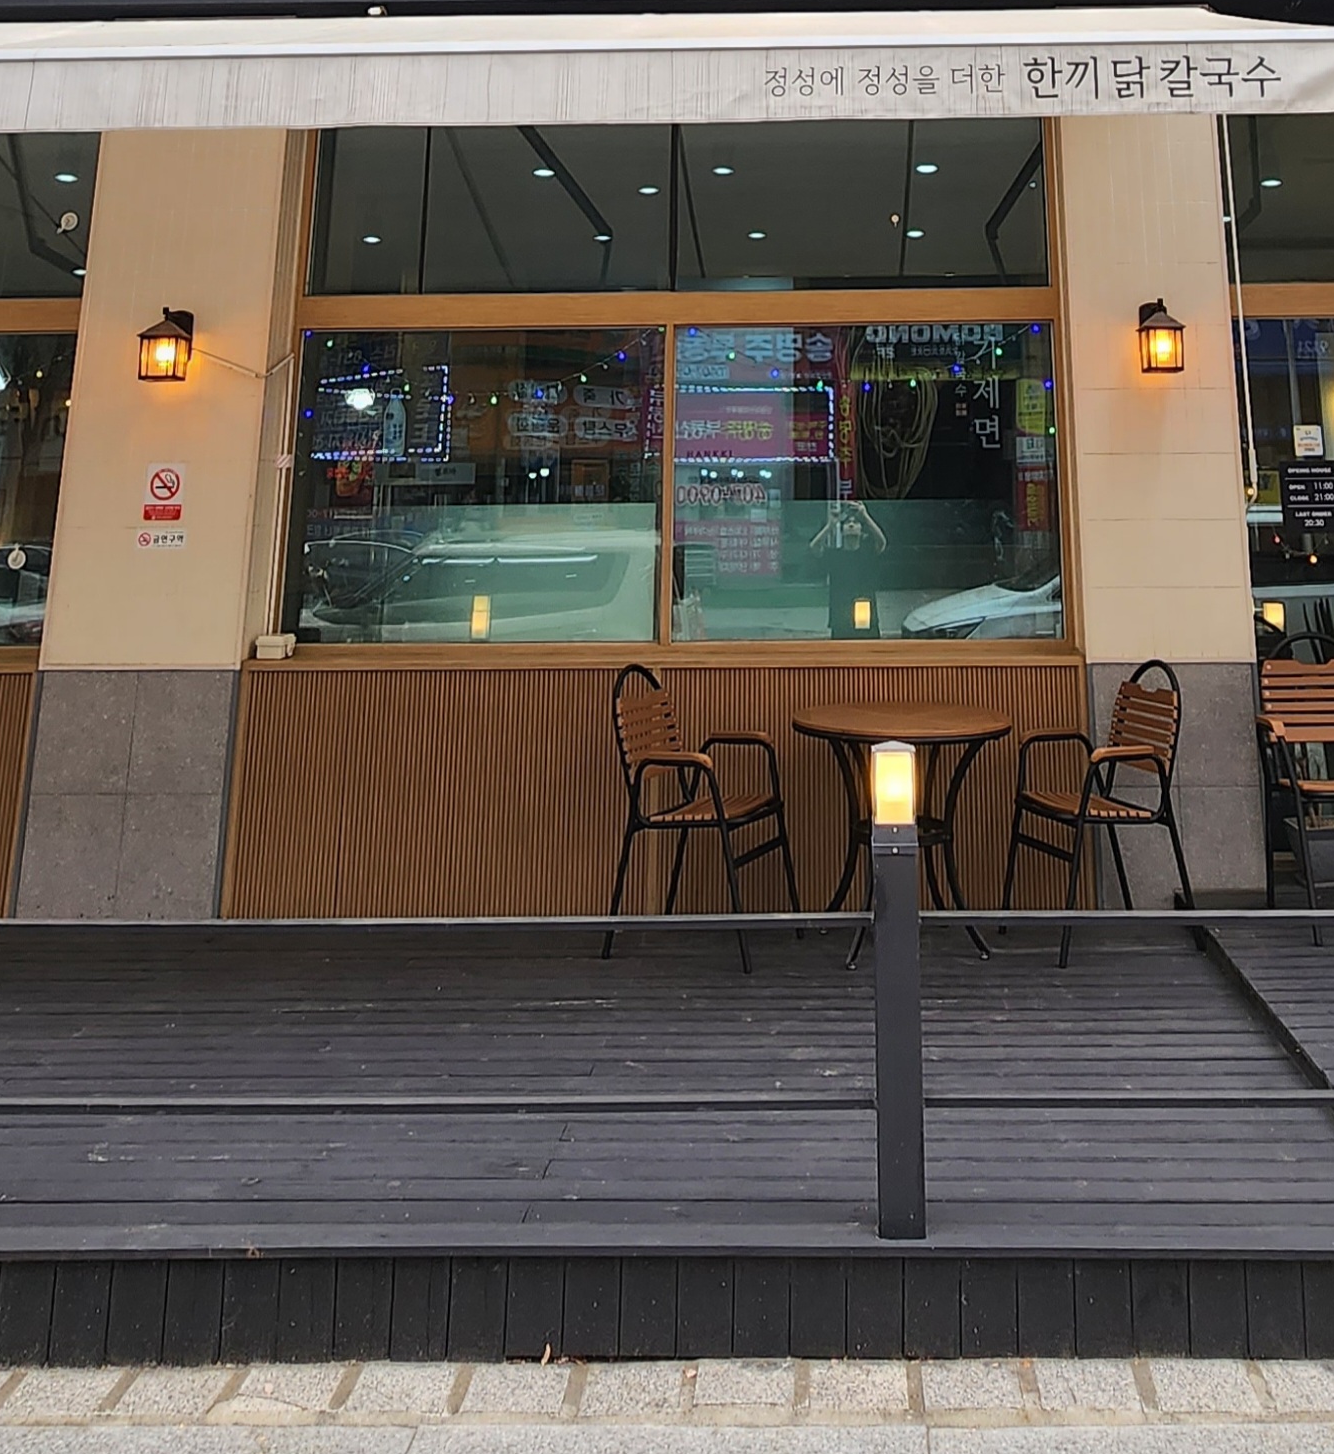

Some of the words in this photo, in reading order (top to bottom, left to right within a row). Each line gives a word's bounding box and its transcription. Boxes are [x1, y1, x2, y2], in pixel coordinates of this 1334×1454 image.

[764, 66, 845, 98] 정성에
[857, 64, 940, 96] 정성을
[951, 63, 1007, 95] 더한
[1022, 56, 1100, 100] 한끼
[1111, 56, 1151, 99] 닭
[1160, 55, 1283, 99] 칼국수
[1314, 482, 1334, 490] 11:00
[1314, 493, 1334, 501] 21:00
